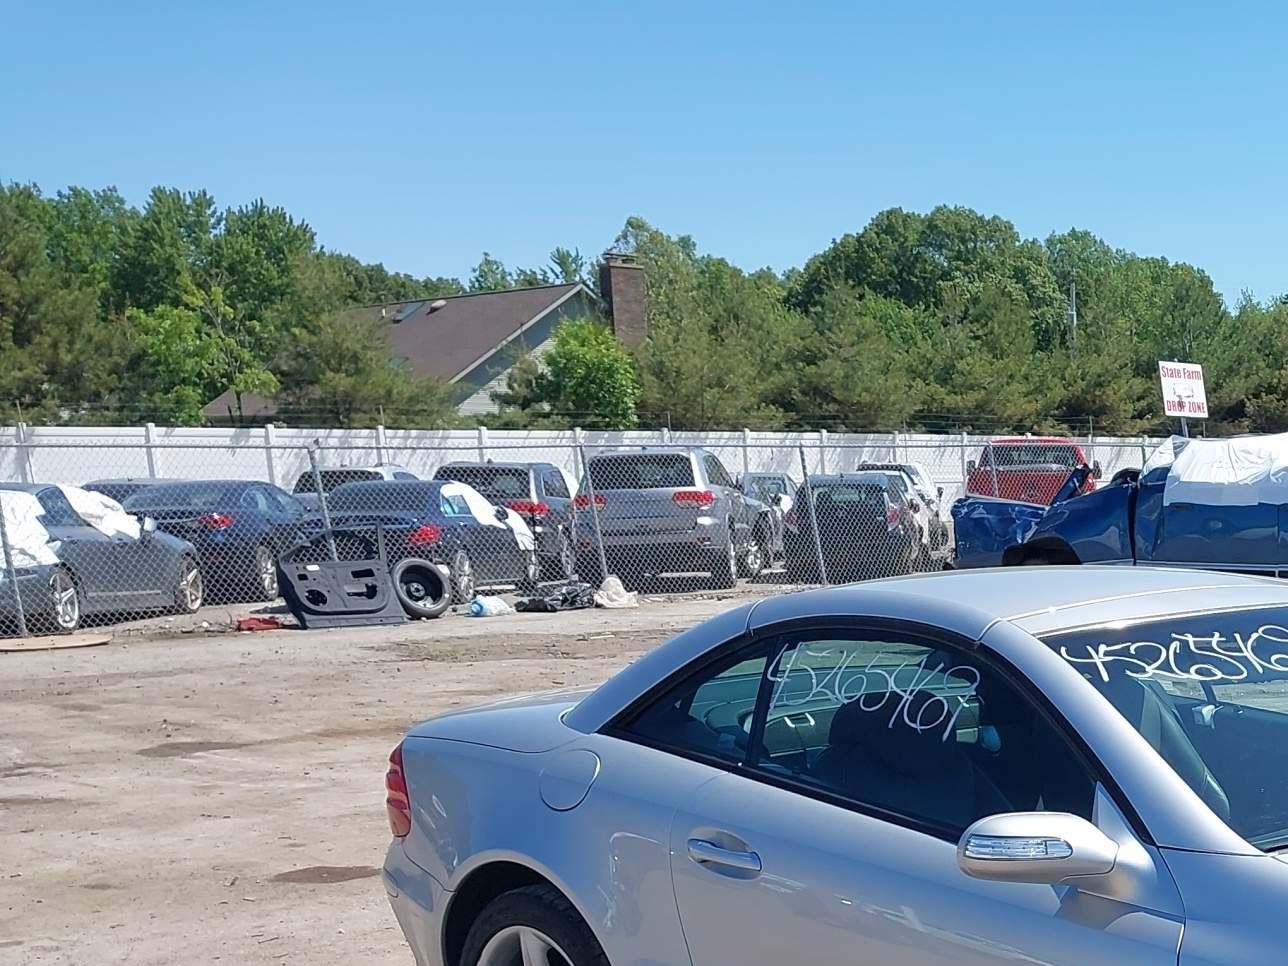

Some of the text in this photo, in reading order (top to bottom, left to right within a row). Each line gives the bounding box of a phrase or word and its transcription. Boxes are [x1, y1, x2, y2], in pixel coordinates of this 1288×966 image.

[1161, 366, 1202, 381] State Farm
[1166, 400, 1206, 413] DROP ZONE
[766, 640, 982, 742] 45265469
